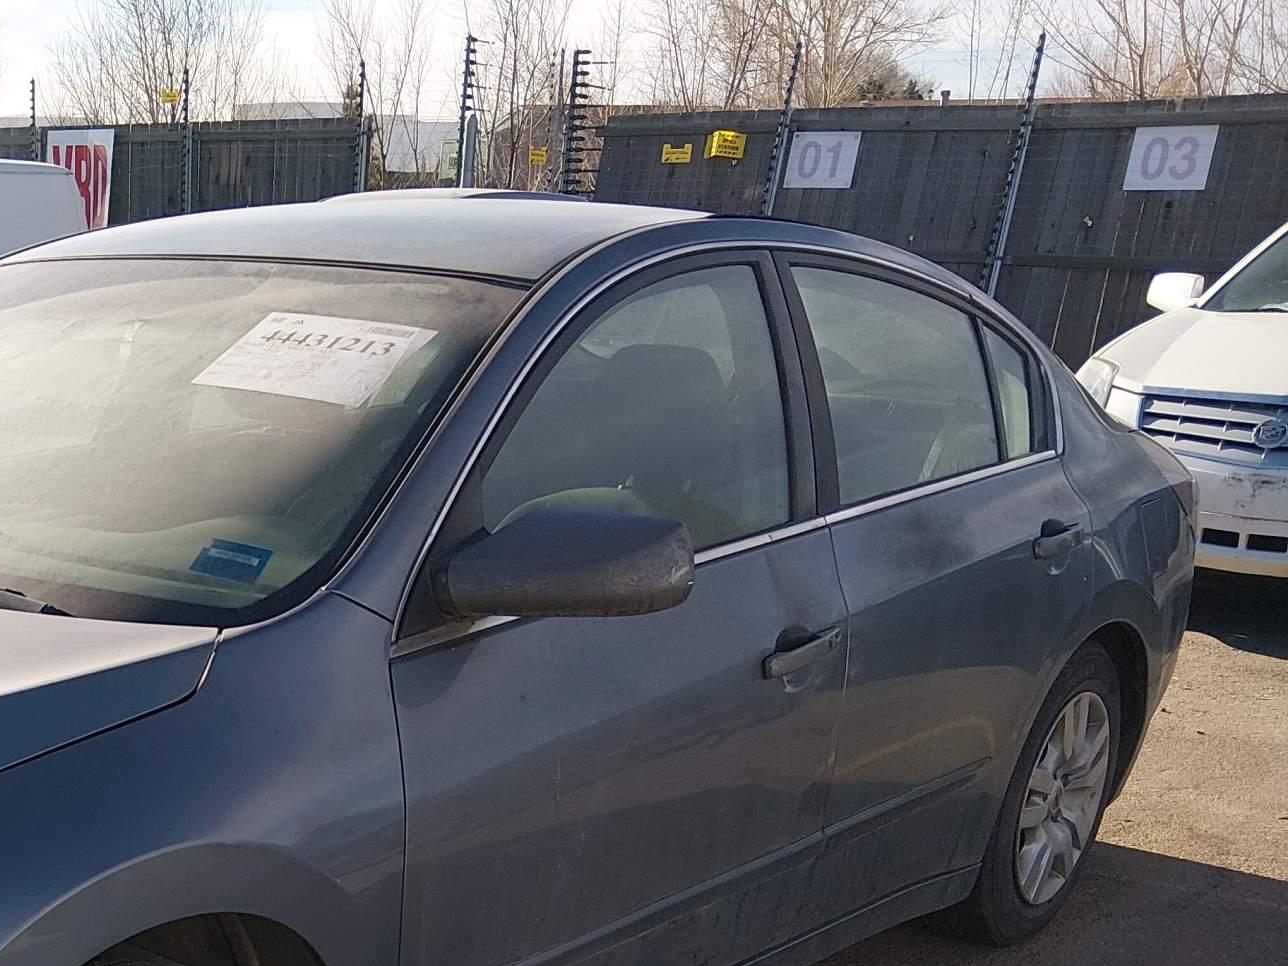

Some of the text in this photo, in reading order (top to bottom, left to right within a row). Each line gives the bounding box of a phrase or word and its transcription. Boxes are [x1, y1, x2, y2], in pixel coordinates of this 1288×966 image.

[797, 140, 843, 179] 01
[1140, 136, 1200, 180] 03
[260, 329, 396, 356] 44431213
